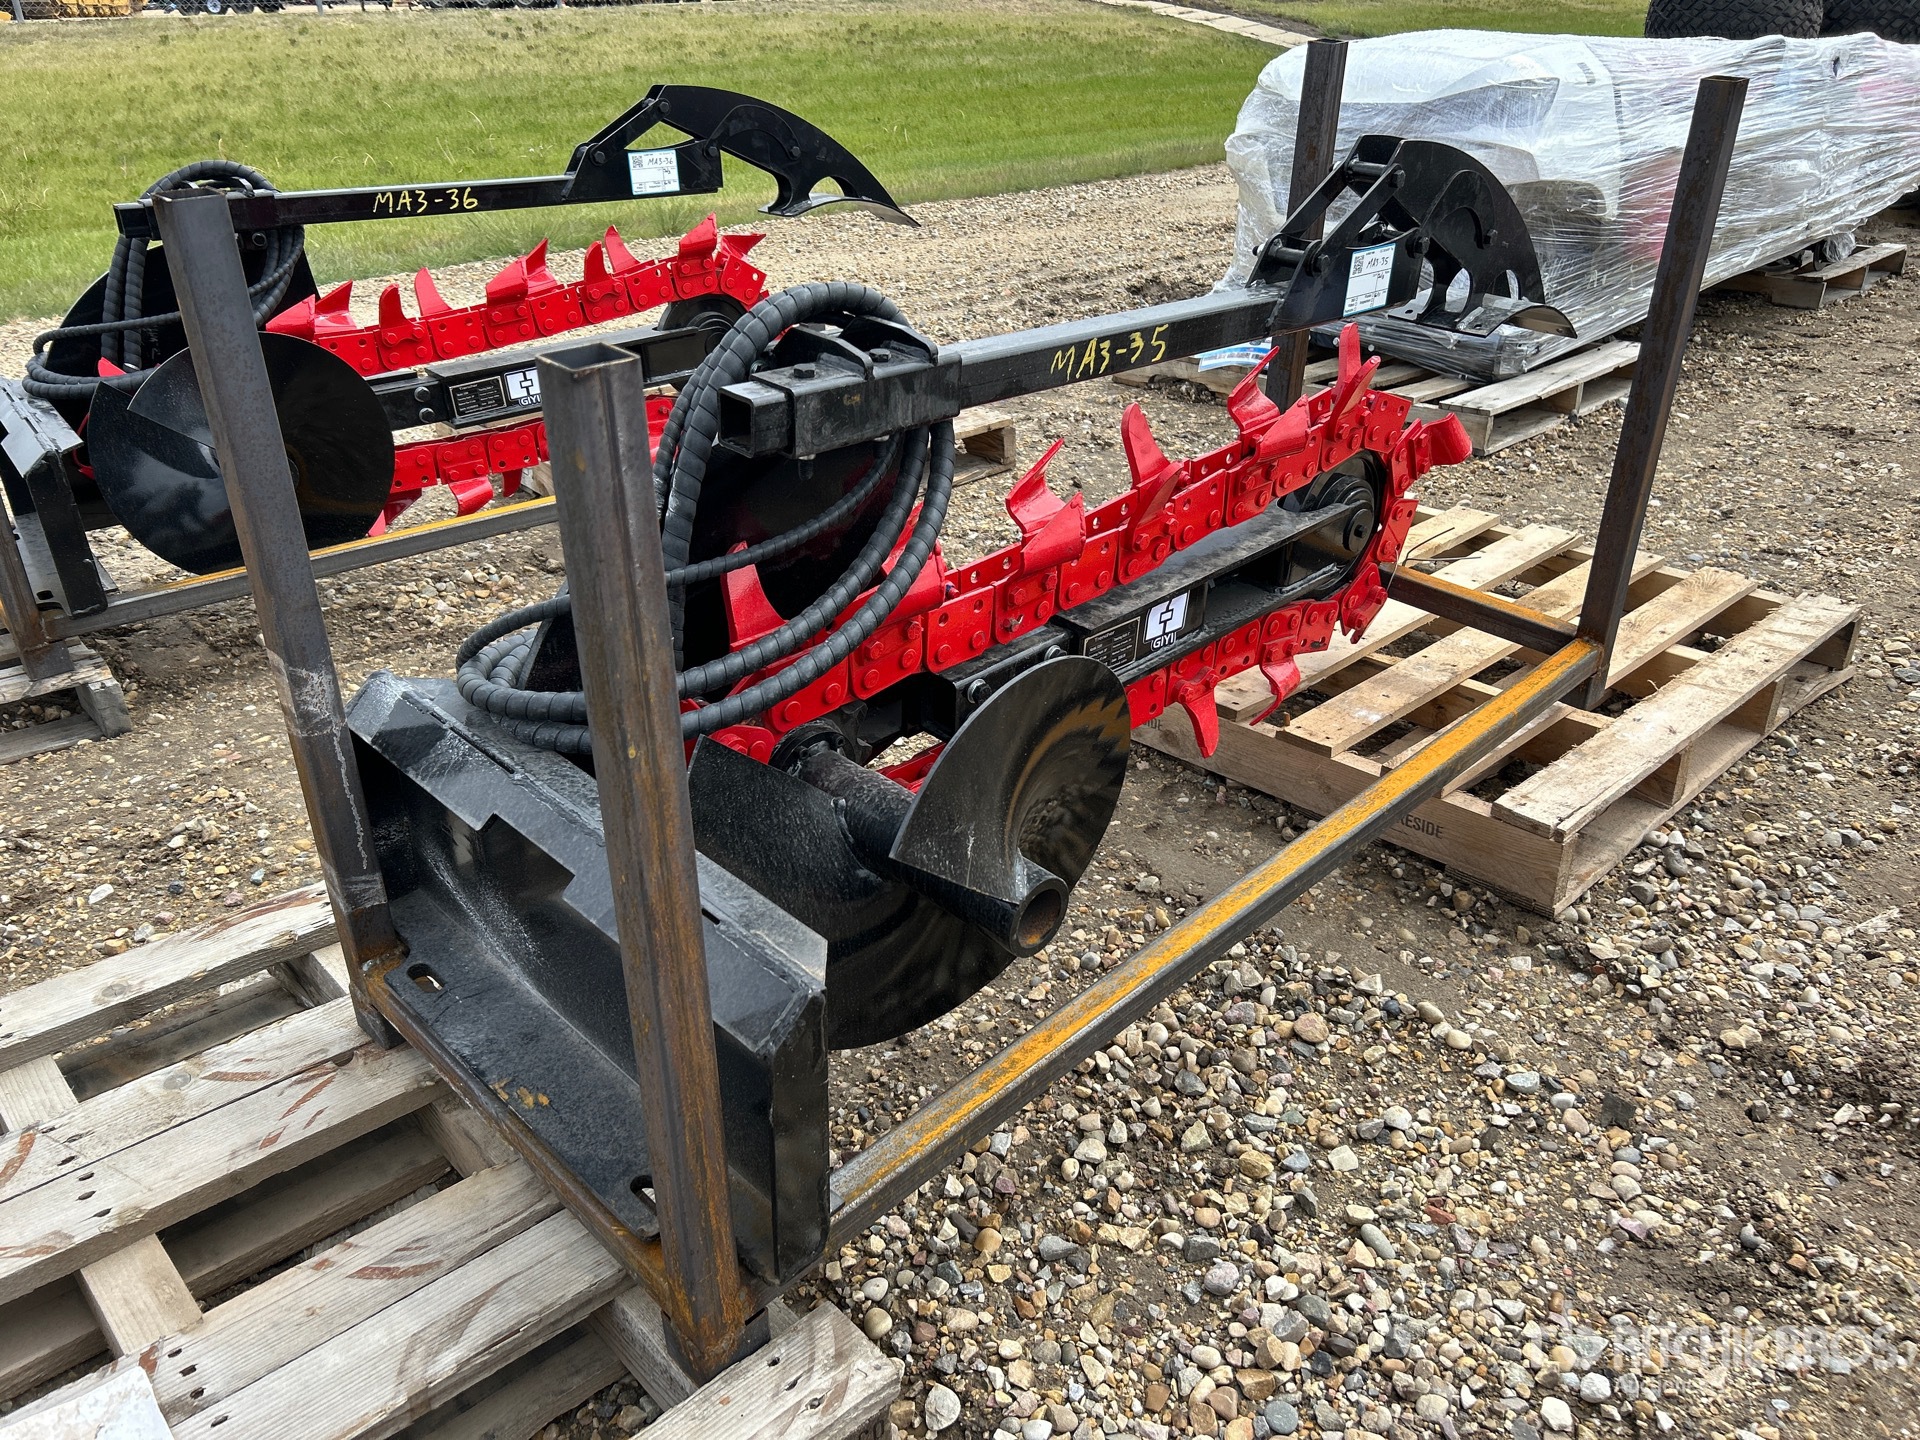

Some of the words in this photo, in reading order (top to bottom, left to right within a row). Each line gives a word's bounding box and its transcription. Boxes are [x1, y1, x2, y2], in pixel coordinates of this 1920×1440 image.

[373, 187, 478, 213] MA3-36
[1050, 324, 1168, 382] MA3-35
[520, 395, 541, 406] GIYI
[1153, 633, 1174, 649] GIYI
